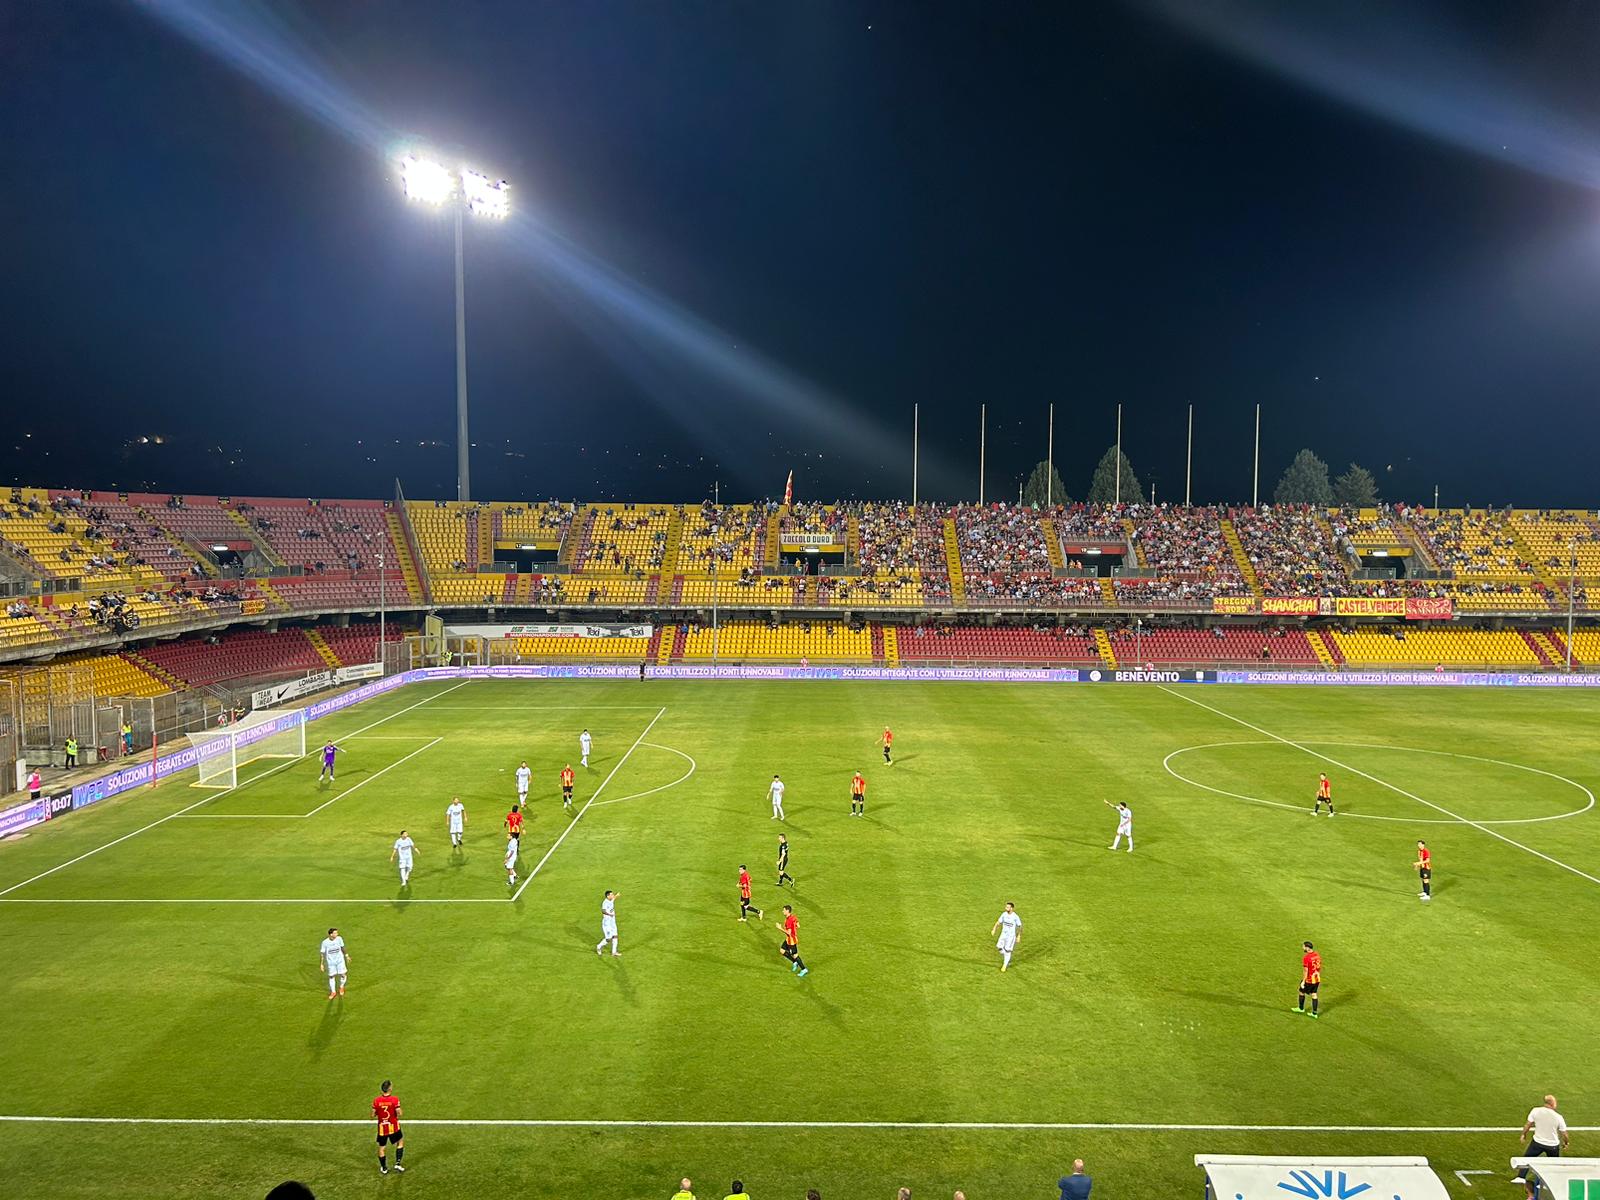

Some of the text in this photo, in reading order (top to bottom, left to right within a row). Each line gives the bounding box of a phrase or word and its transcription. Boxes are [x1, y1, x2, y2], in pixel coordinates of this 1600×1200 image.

[1262, 599, 1318, 612] SHANGHAI
[1338, 600, 1404, 614] CASTELVENERE
[1115, 671, 1180, 681] BENEVENTO
[108, 766, 147, 790] SOLUZIONI
[182, 750, 196, 763] CON
[52, 794, 72, 812] 10:07
[381, 1106, 390, 1120] 3
